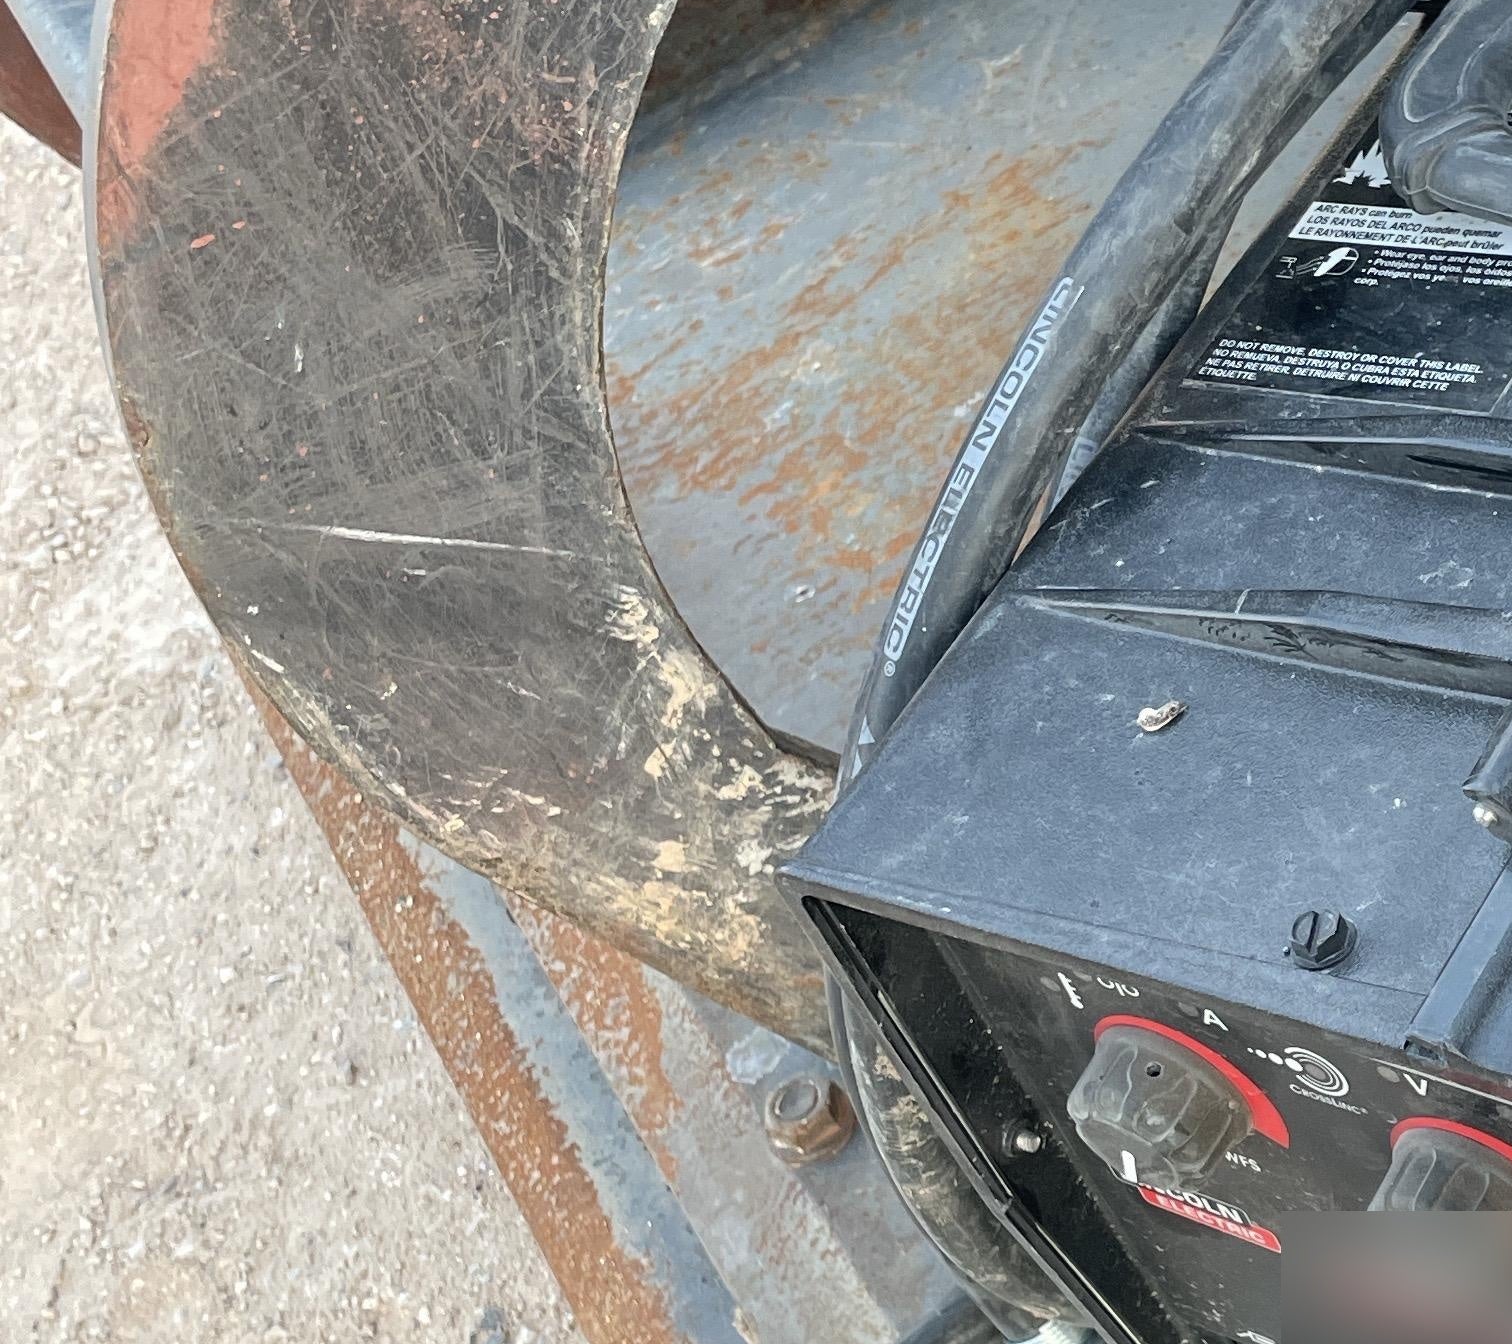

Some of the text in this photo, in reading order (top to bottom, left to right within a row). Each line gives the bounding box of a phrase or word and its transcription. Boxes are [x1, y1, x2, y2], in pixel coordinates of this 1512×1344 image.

[1307, 216, 1330, 225] LOS
[1331, 217, 1365, 228] RAYOS
[1367, 219, 1390, 230] DEL
[1390, 222, 1422, 232] ARCO
[1314, 204, 1339, 213] ARC
[1340, 205, 1369, 216] RAYS
[1299, 227, 1314, 236] LE
[1315, 227, 1395, 243] RAYONNEMENT
[1394, 234, 1411, 244] DE
[1213, 348, 1229, 356] NO
[1283, 355, 1340, 370] DESTRUYA
[1352, 363, 1390, 375] CUBRA
[1391, 367, 1420, 378] ESTA
[1219, 339, 1236, 348] DO
[1236, 340, 1260, 350] NOT
[1308, 348, 1361, 362] DESTROY
[1358, 353, 1378, 363] OR
[1379, 355, 1418, 367] COVER
[1419, 359, 1445, 370] THIS
[1205, 357, 1221, 366] NE
[1222, 359, 1244, 369] PAS
[1361, 374, 1412, 387] COUVRIR
[1412, 379, 1450, 391] CETTE
[886, 280, 1075, 656] LINCOLN ELECTRIC
[1155, 1196, 1267, 1244] ELECTRIC
